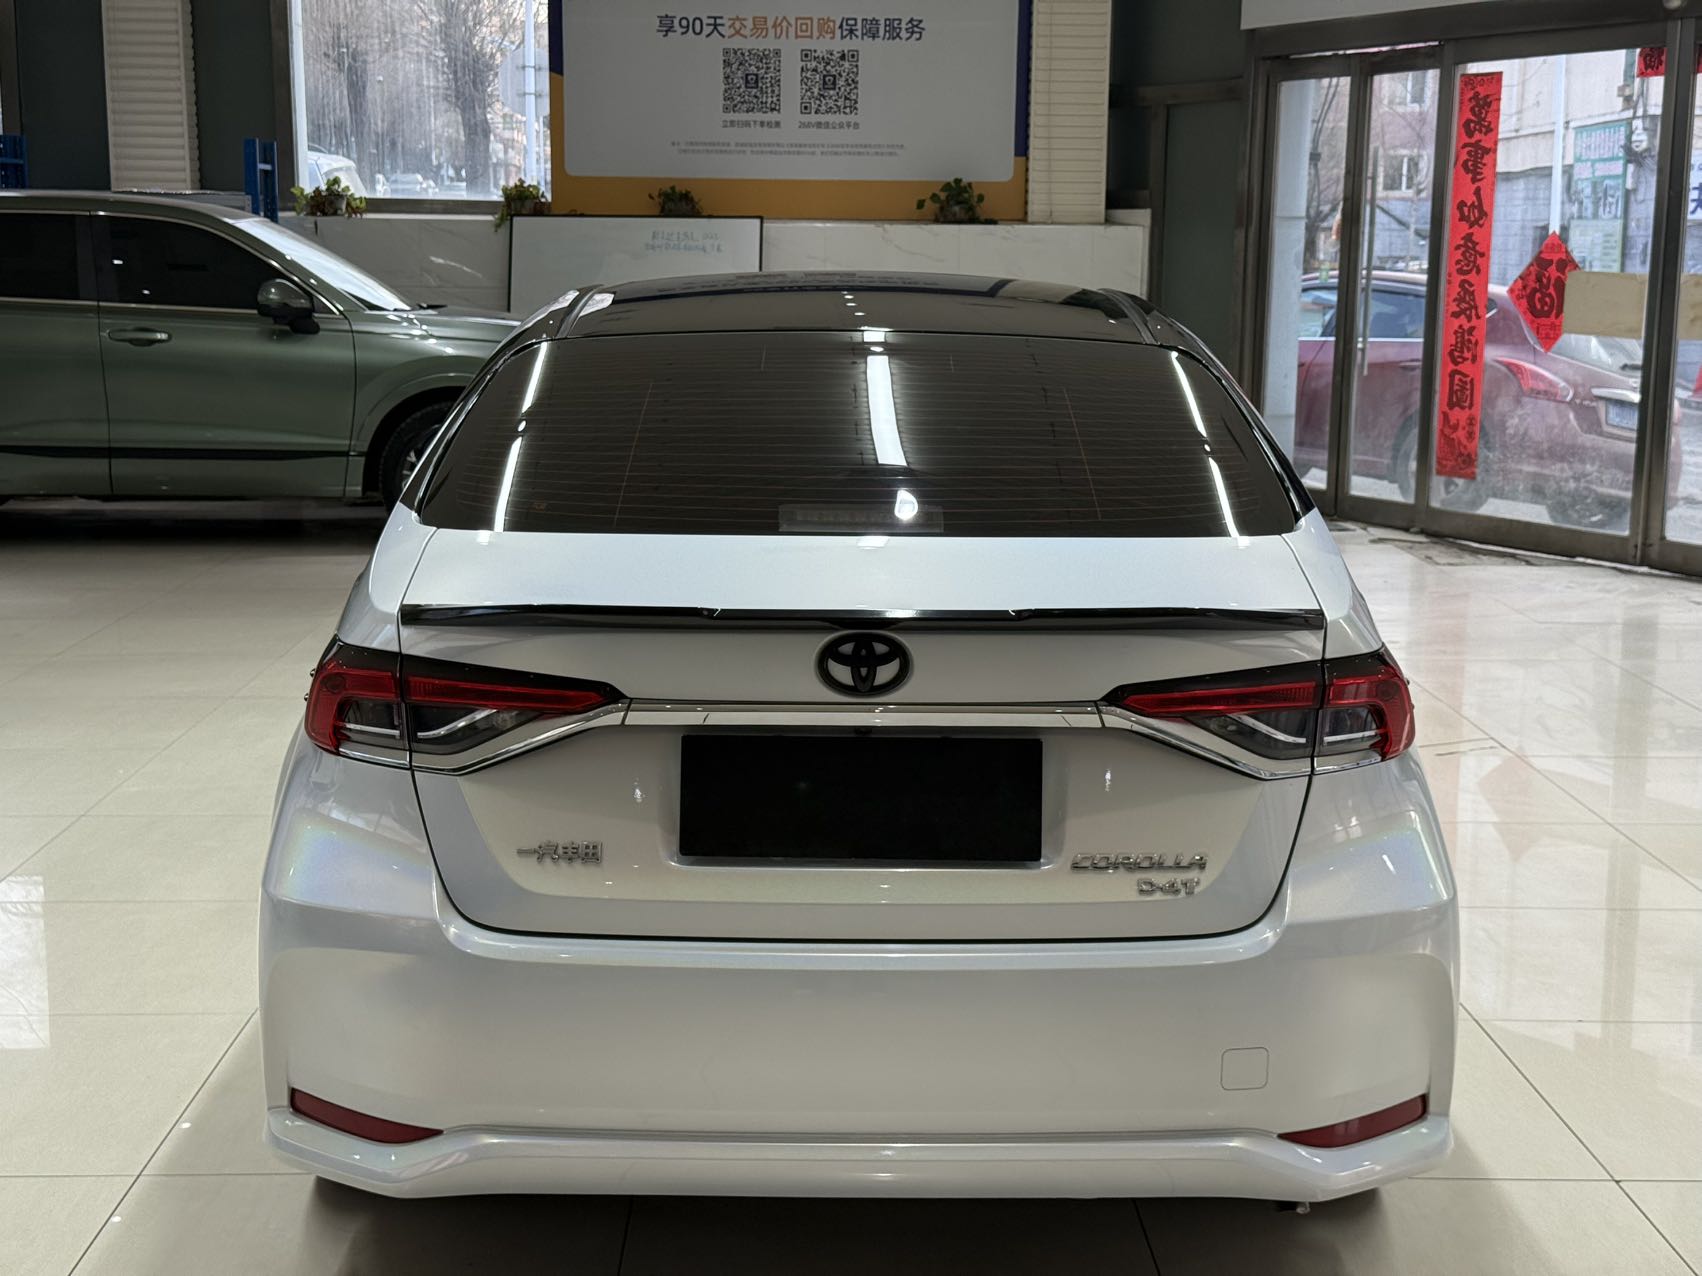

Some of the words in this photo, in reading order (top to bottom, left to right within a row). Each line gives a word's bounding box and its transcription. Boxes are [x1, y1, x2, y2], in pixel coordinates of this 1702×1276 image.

[656, 14, 926, 41] 享90天交易价回购保障服务
[1071, 853, 1207, 872] COROLLA
